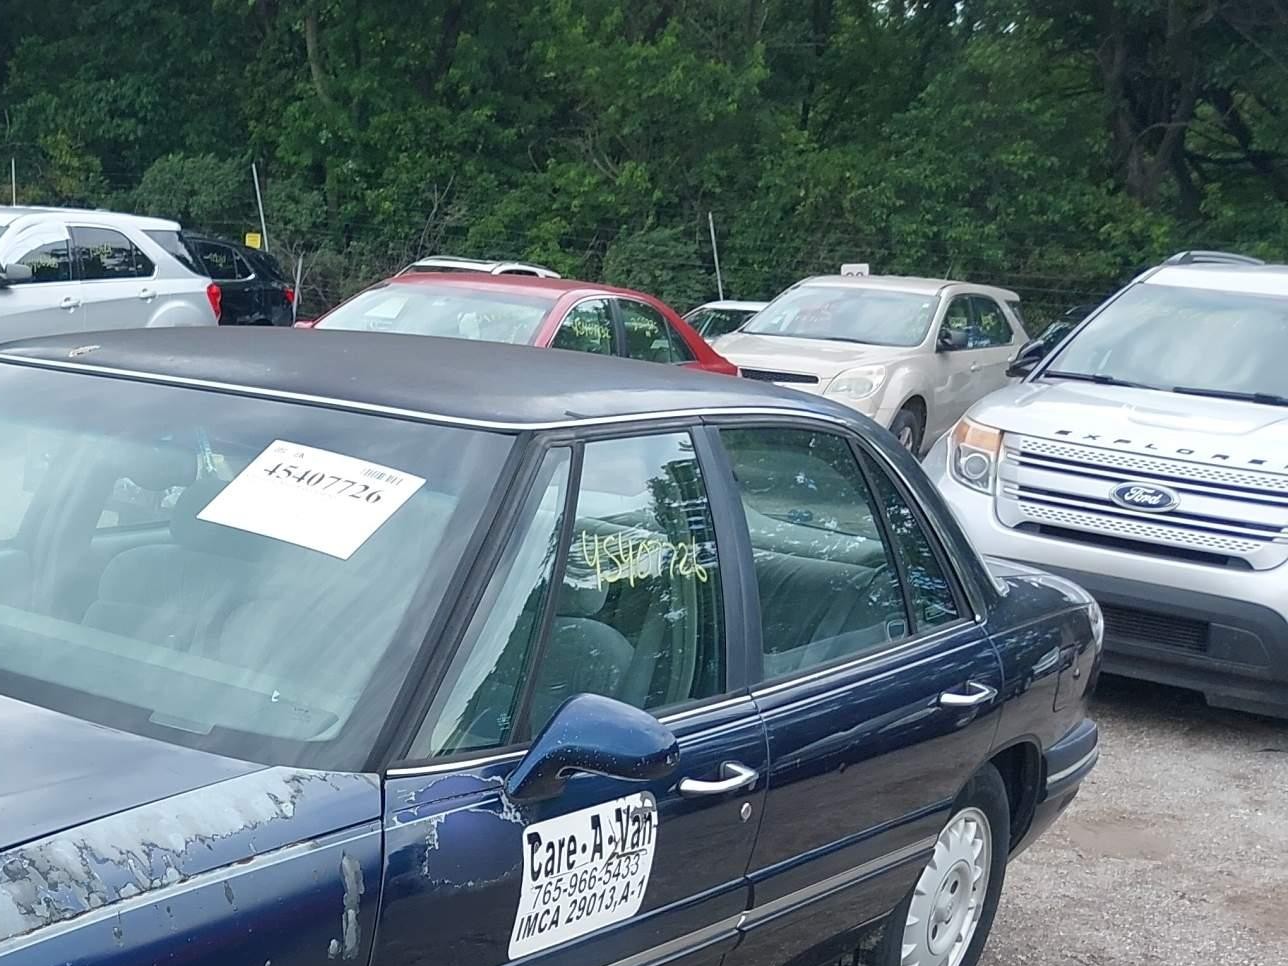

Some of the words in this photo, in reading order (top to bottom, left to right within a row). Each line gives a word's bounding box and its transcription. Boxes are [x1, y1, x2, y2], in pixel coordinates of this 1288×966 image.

[1055, 429, 1288, 469] EXPLORE
[264, 462, 382, 504] 45407726
[1123, 486, 1163, 505] Ford
[582, 530, 708, 592] 45407726
[532, 854, 641, 910] 765-966-5433
[515, 904, 561, 942] IMCA
